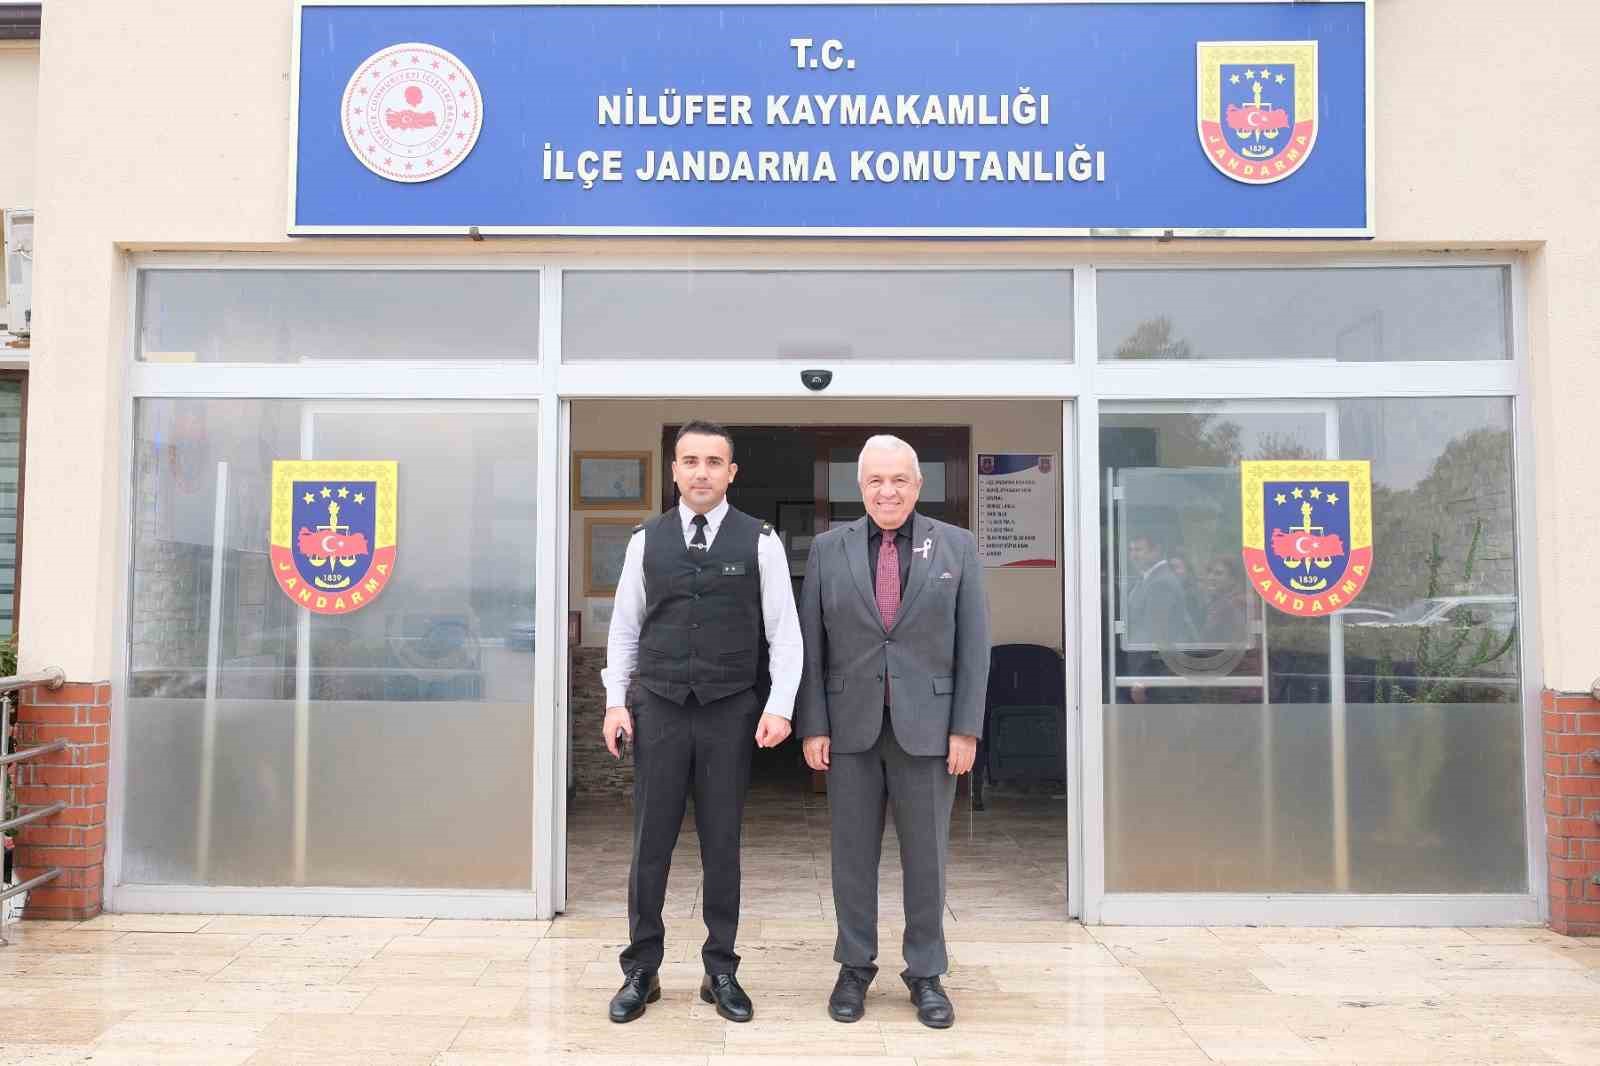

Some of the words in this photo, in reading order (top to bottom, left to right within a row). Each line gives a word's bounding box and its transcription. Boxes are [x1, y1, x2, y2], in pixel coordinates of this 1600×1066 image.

[790, 38, 855, 70] T.C.
[598, 87, 754, 125] NİLÜFER
[767, 86, 1050, 125] KAYMAKAMLIĞI
[543, 143, 623, 190] İLÇE
[636, 150, 838, 182] JANDARMA
[850, 143, 1106, 182] KOMUTANLIĞI
[1209, 136, 1306, 176] JANDARMA
[279, 561, 389, 608] JANDARMA
[323, 573, 343, 582] 1839
[1252, 563, 1366, 611] JANDARMA
[1298, 574, 1319, 584] 1839
